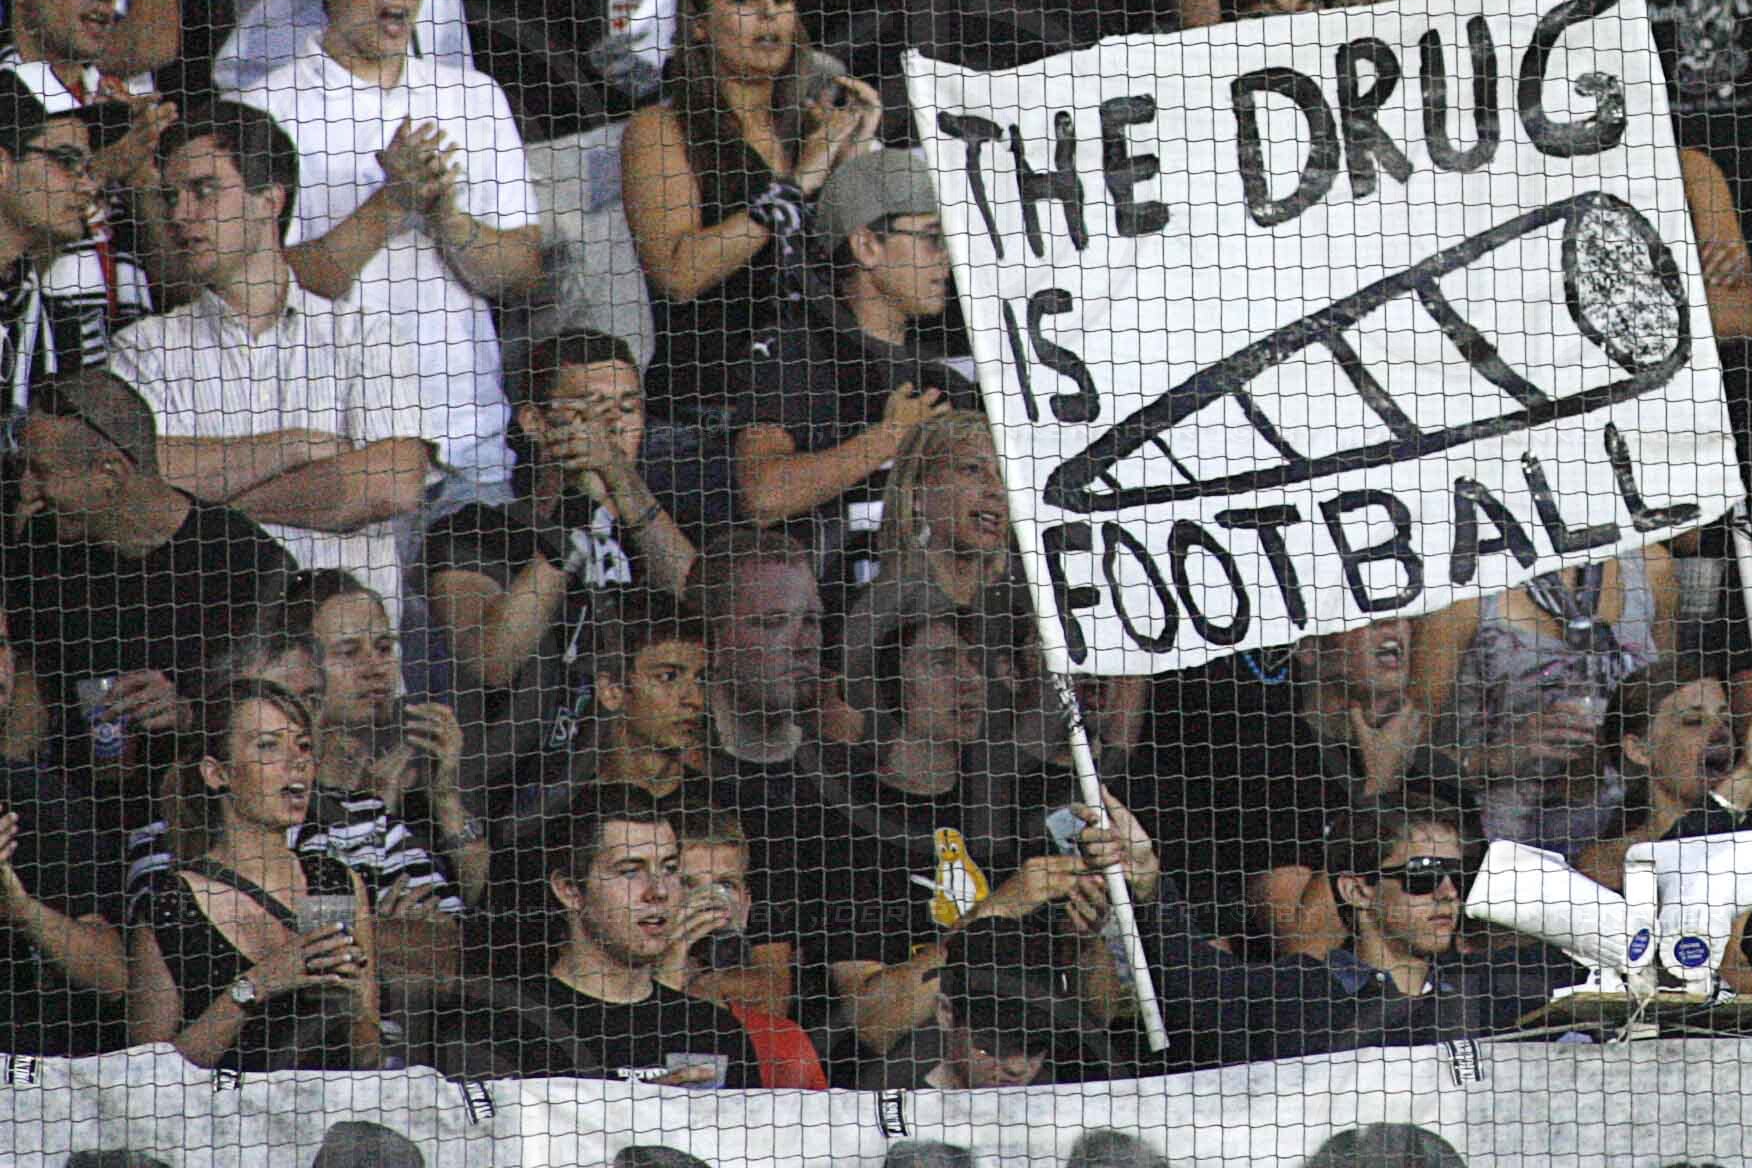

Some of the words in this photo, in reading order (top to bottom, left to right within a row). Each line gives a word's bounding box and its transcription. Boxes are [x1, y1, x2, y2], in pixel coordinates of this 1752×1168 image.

[937, 93, 1171, 261] THE
[1002, 287, 1101, 423] IS
[1042, 422, 1702, 665] FOOTBALL
